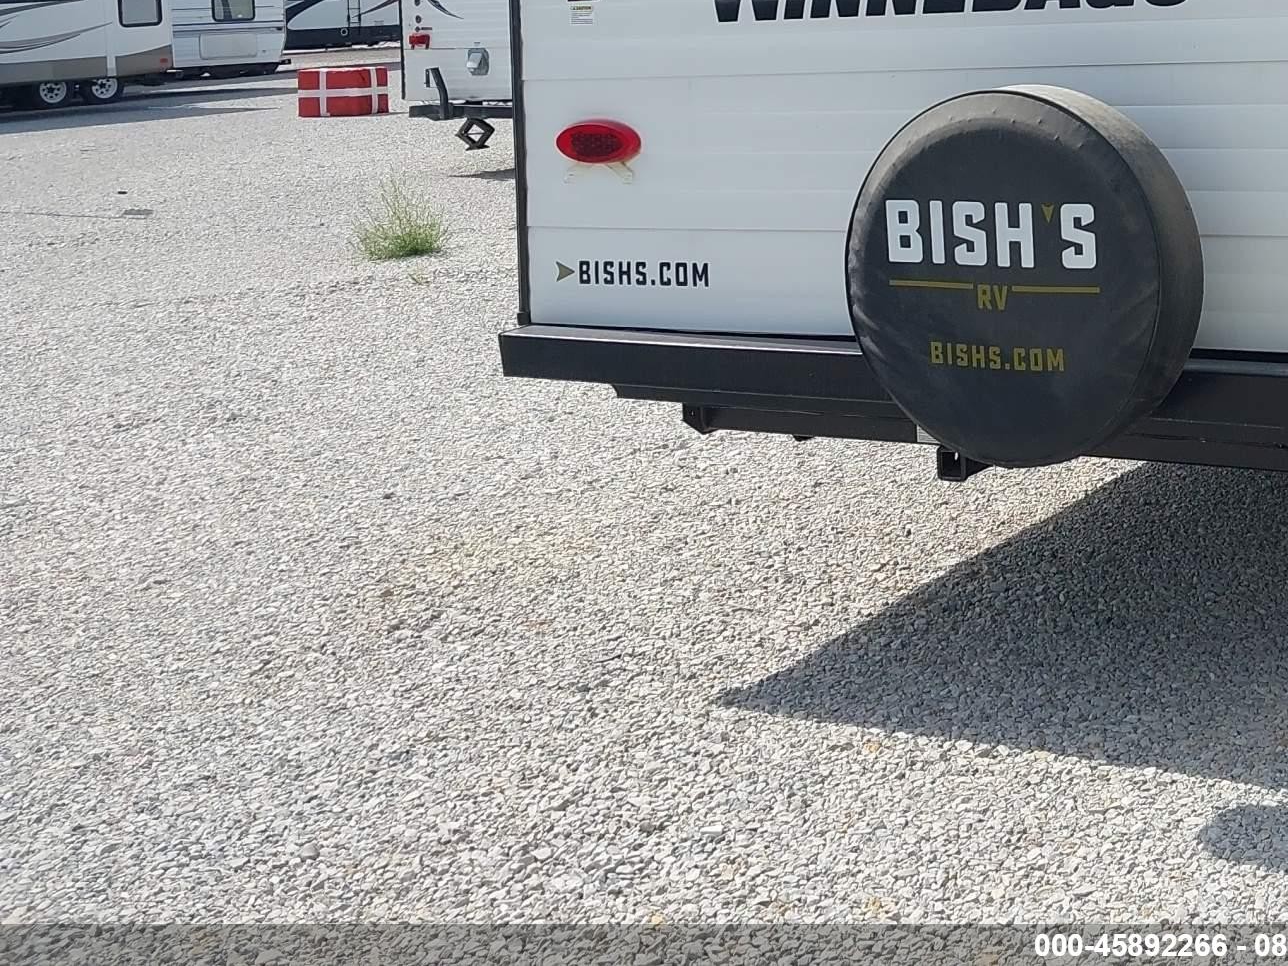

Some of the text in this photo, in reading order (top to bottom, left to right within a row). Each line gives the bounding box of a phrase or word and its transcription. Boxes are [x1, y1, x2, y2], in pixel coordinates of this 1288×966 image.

[886, 200, 1096, 269] BISH'S
[579, 260, 709, 287] BISHS.COM
[977, 285, 1008, 310] RV
[930, 341, 1065, 372] BISHS.COM
